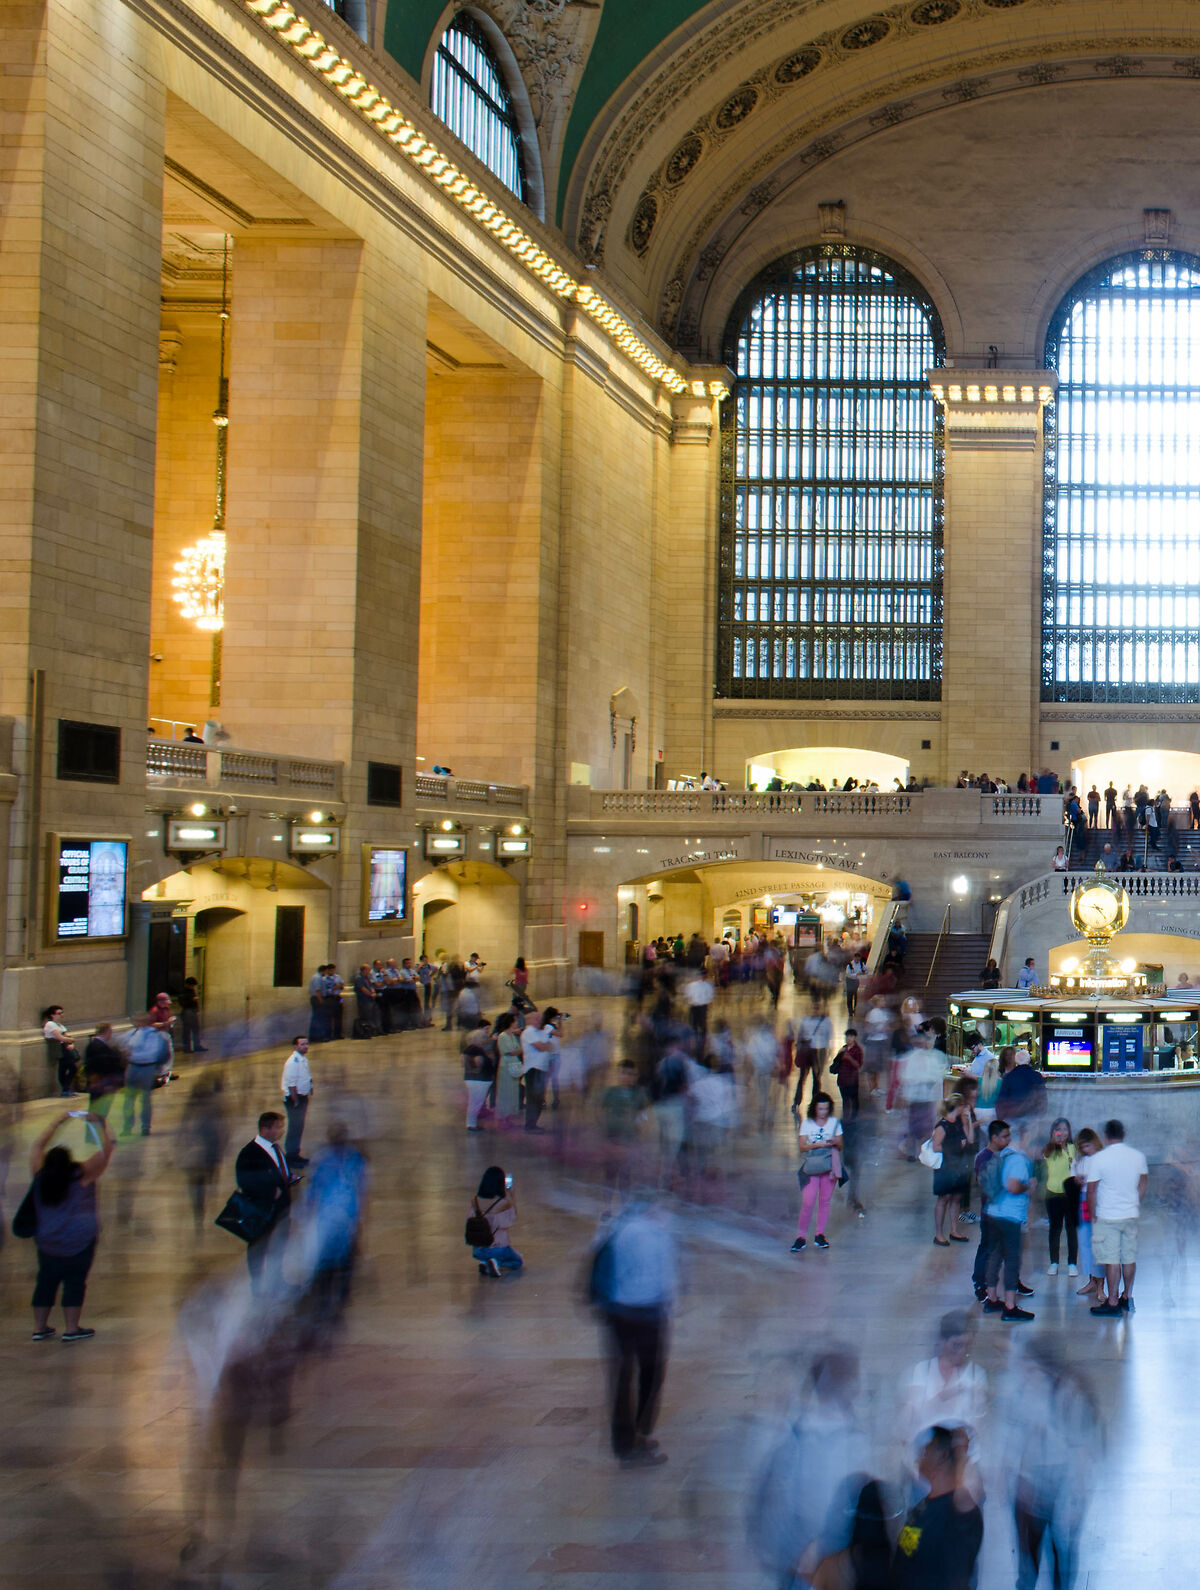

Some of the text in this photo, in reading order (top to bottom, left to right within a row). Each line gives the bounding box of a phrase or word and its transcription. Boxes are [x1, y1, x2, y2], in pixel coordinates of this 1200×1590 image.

[660, 854, 700, 868] TRACKS
[775, 849, 858, 870] LEXINGTON AVE
[933, 851, 990, 859] EAST BALCONY
[758, 883, 788, 893] STREET
[791, 881, 825, 890] PASSAGE
[1161, 926, 1188, 934] DINING
[1079, 976, 1128, 988] Information
